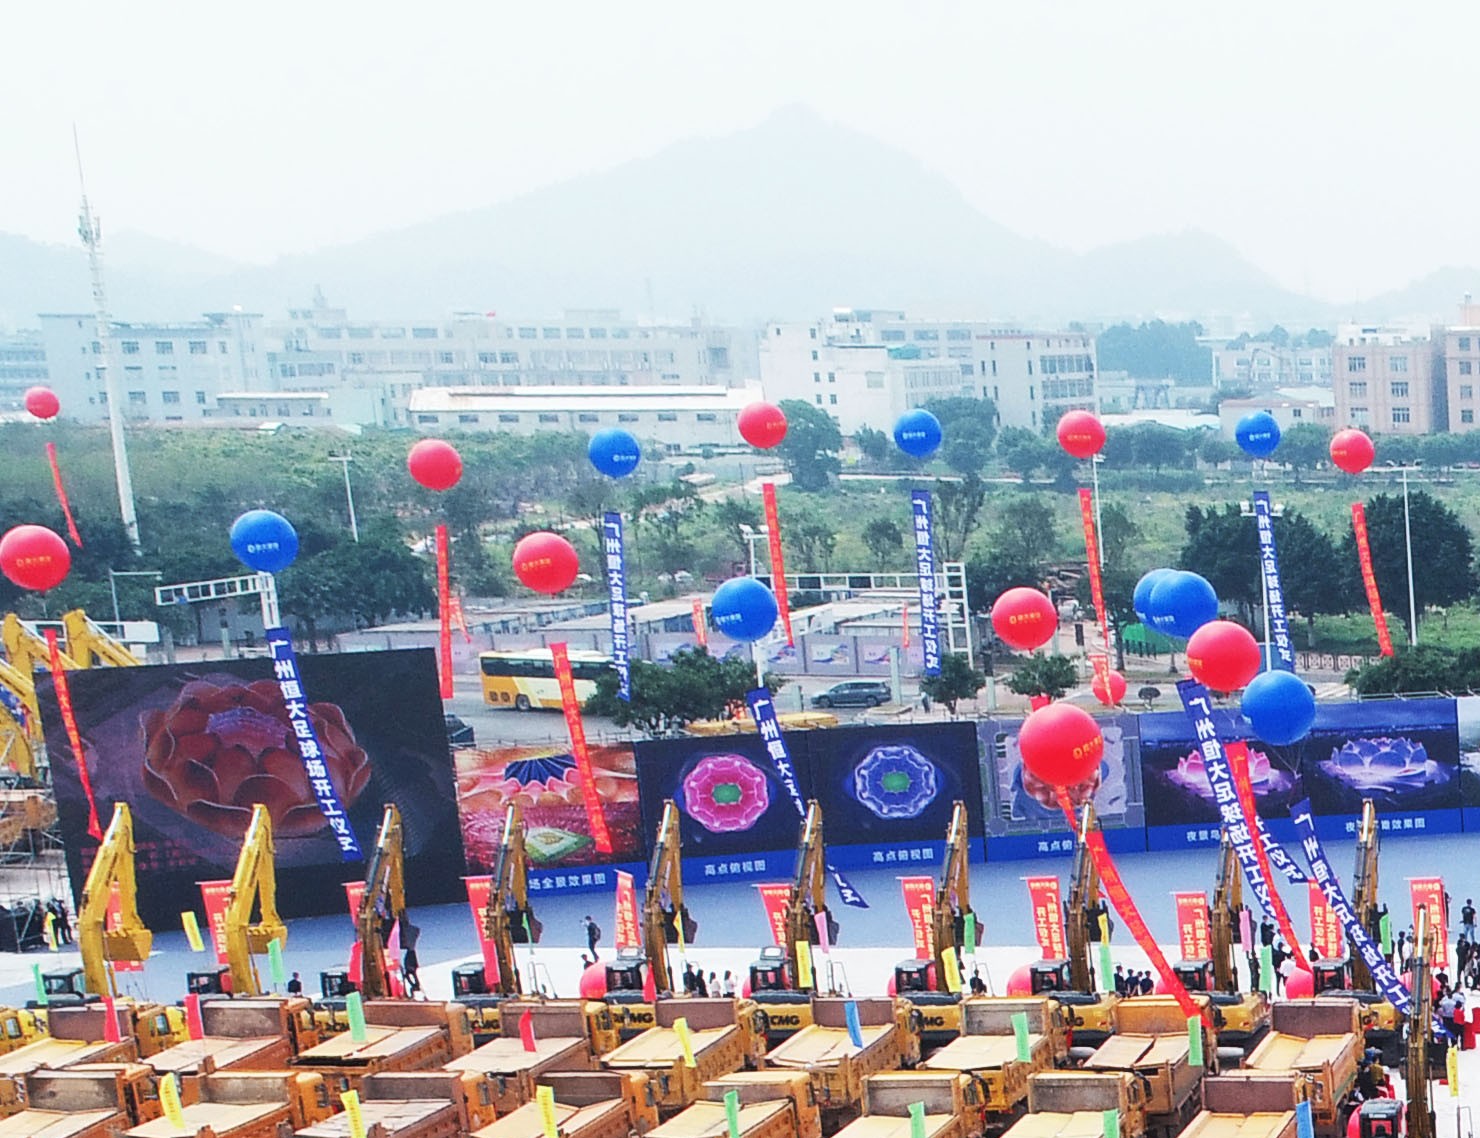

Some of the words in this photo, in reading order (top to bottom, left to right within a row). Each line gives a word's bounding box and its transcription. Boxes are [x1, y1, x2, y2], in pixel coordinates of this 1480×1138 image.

[1346, 818, 1426, 832] 夜瞰效果图
[872, 848, 934, 863] 高点俯视图
[705, 860, 766, 877] 高点俯视图
